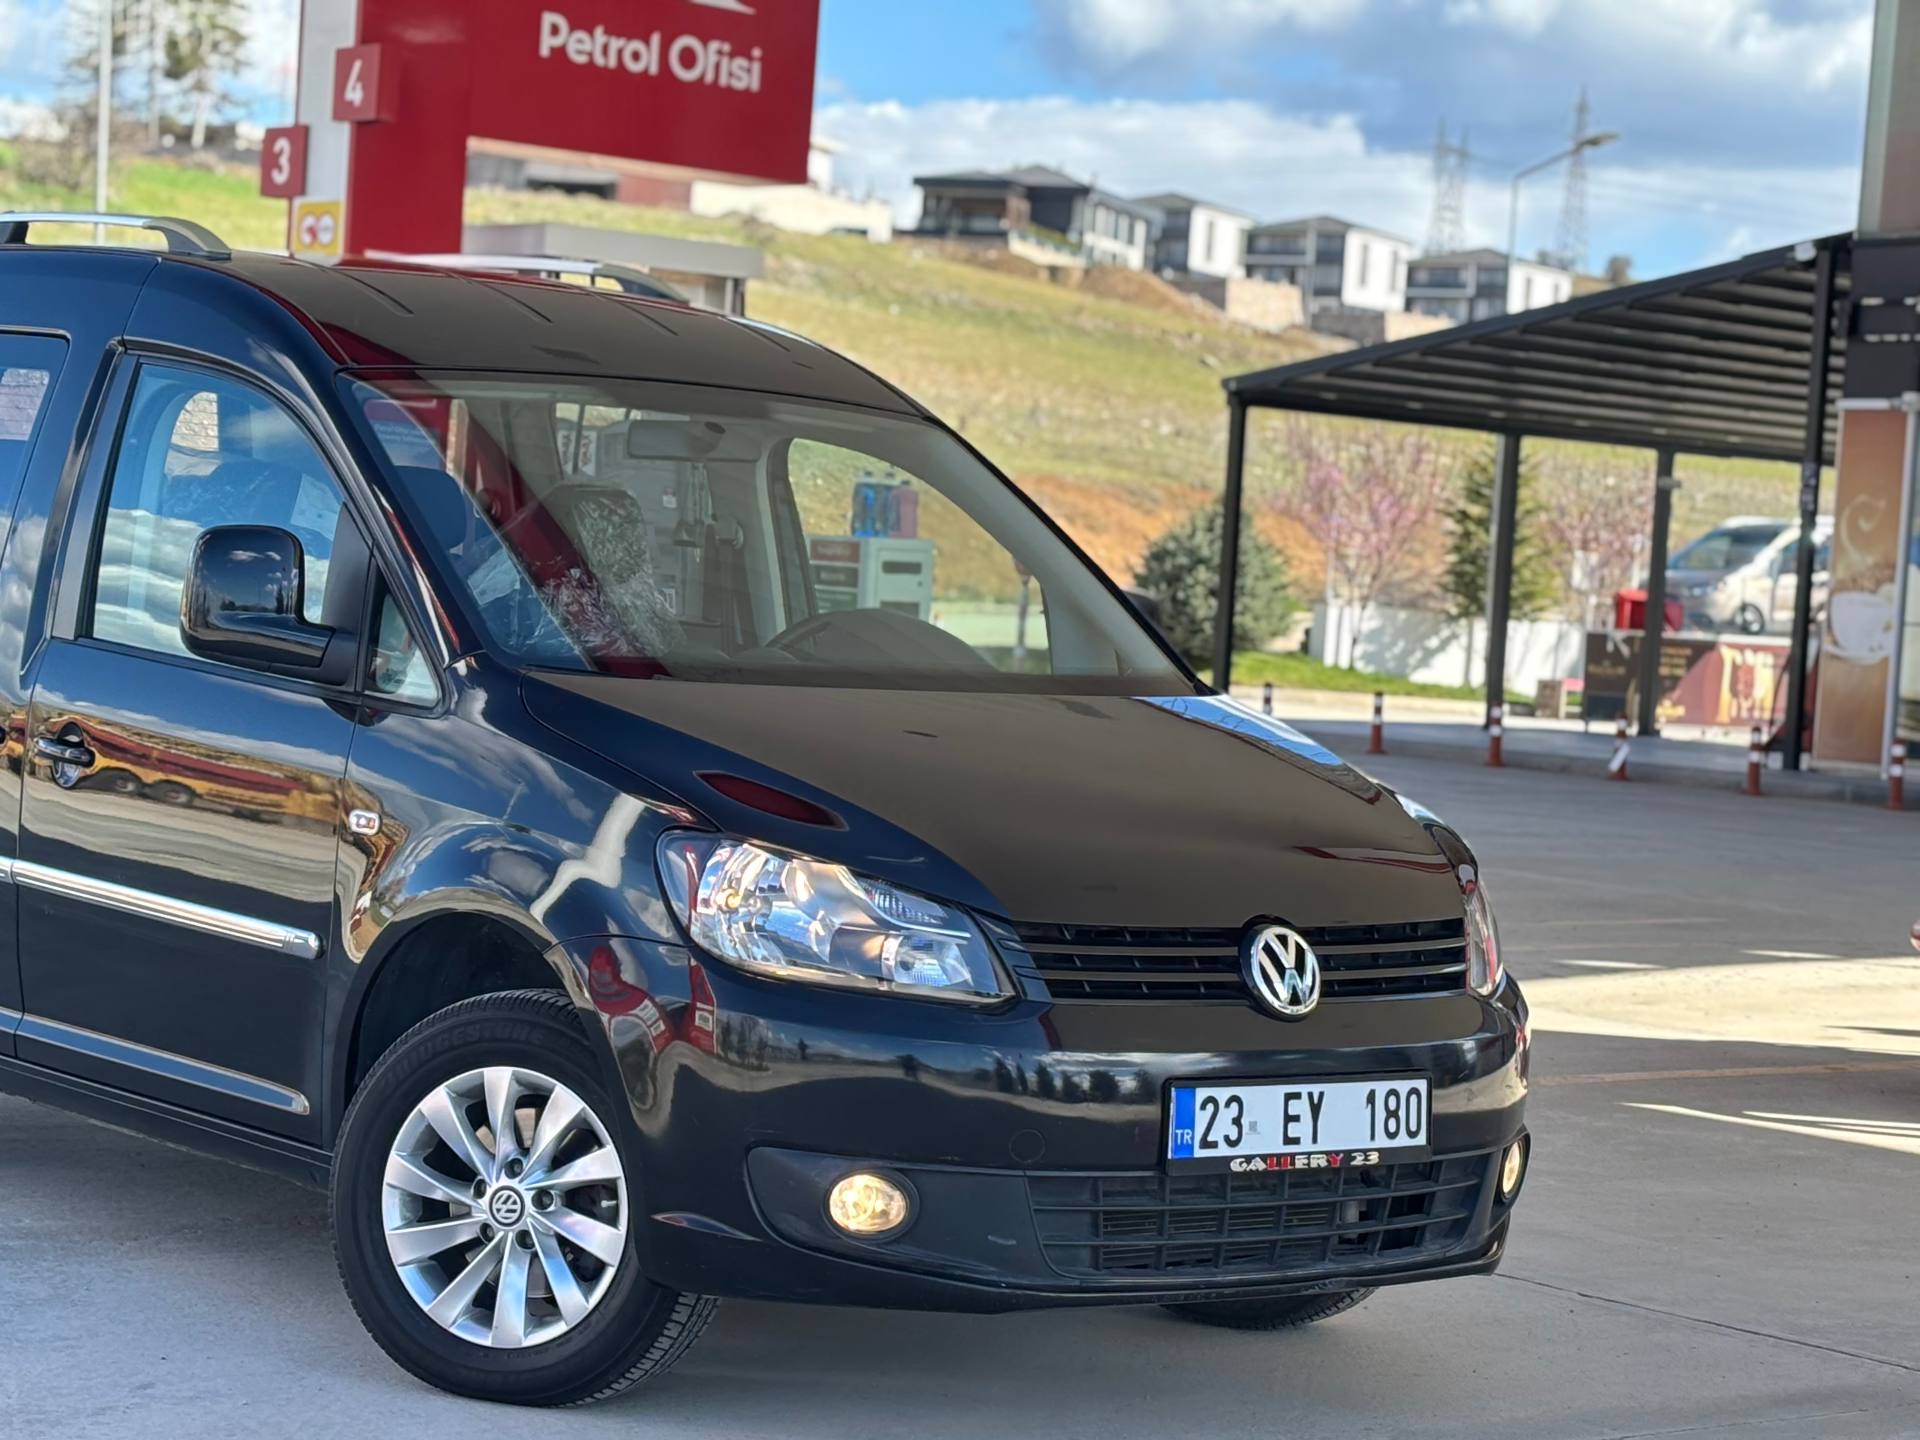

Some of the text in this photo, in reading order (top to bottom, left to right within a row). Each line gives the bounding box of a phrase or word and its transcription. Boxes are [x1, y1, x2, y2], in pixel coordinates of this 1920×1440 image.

[539, 11, 763, 93] Petrol Ofisi
[343, 59, 366, 108] 4
[271, 136, 292, 186] 3
[1175, 1129, 1193, 1145] TR
[1198, 1086, 1423, 1150] 23 EY 180
[1230, 1151, 1380, 1172] GALLERY 23
